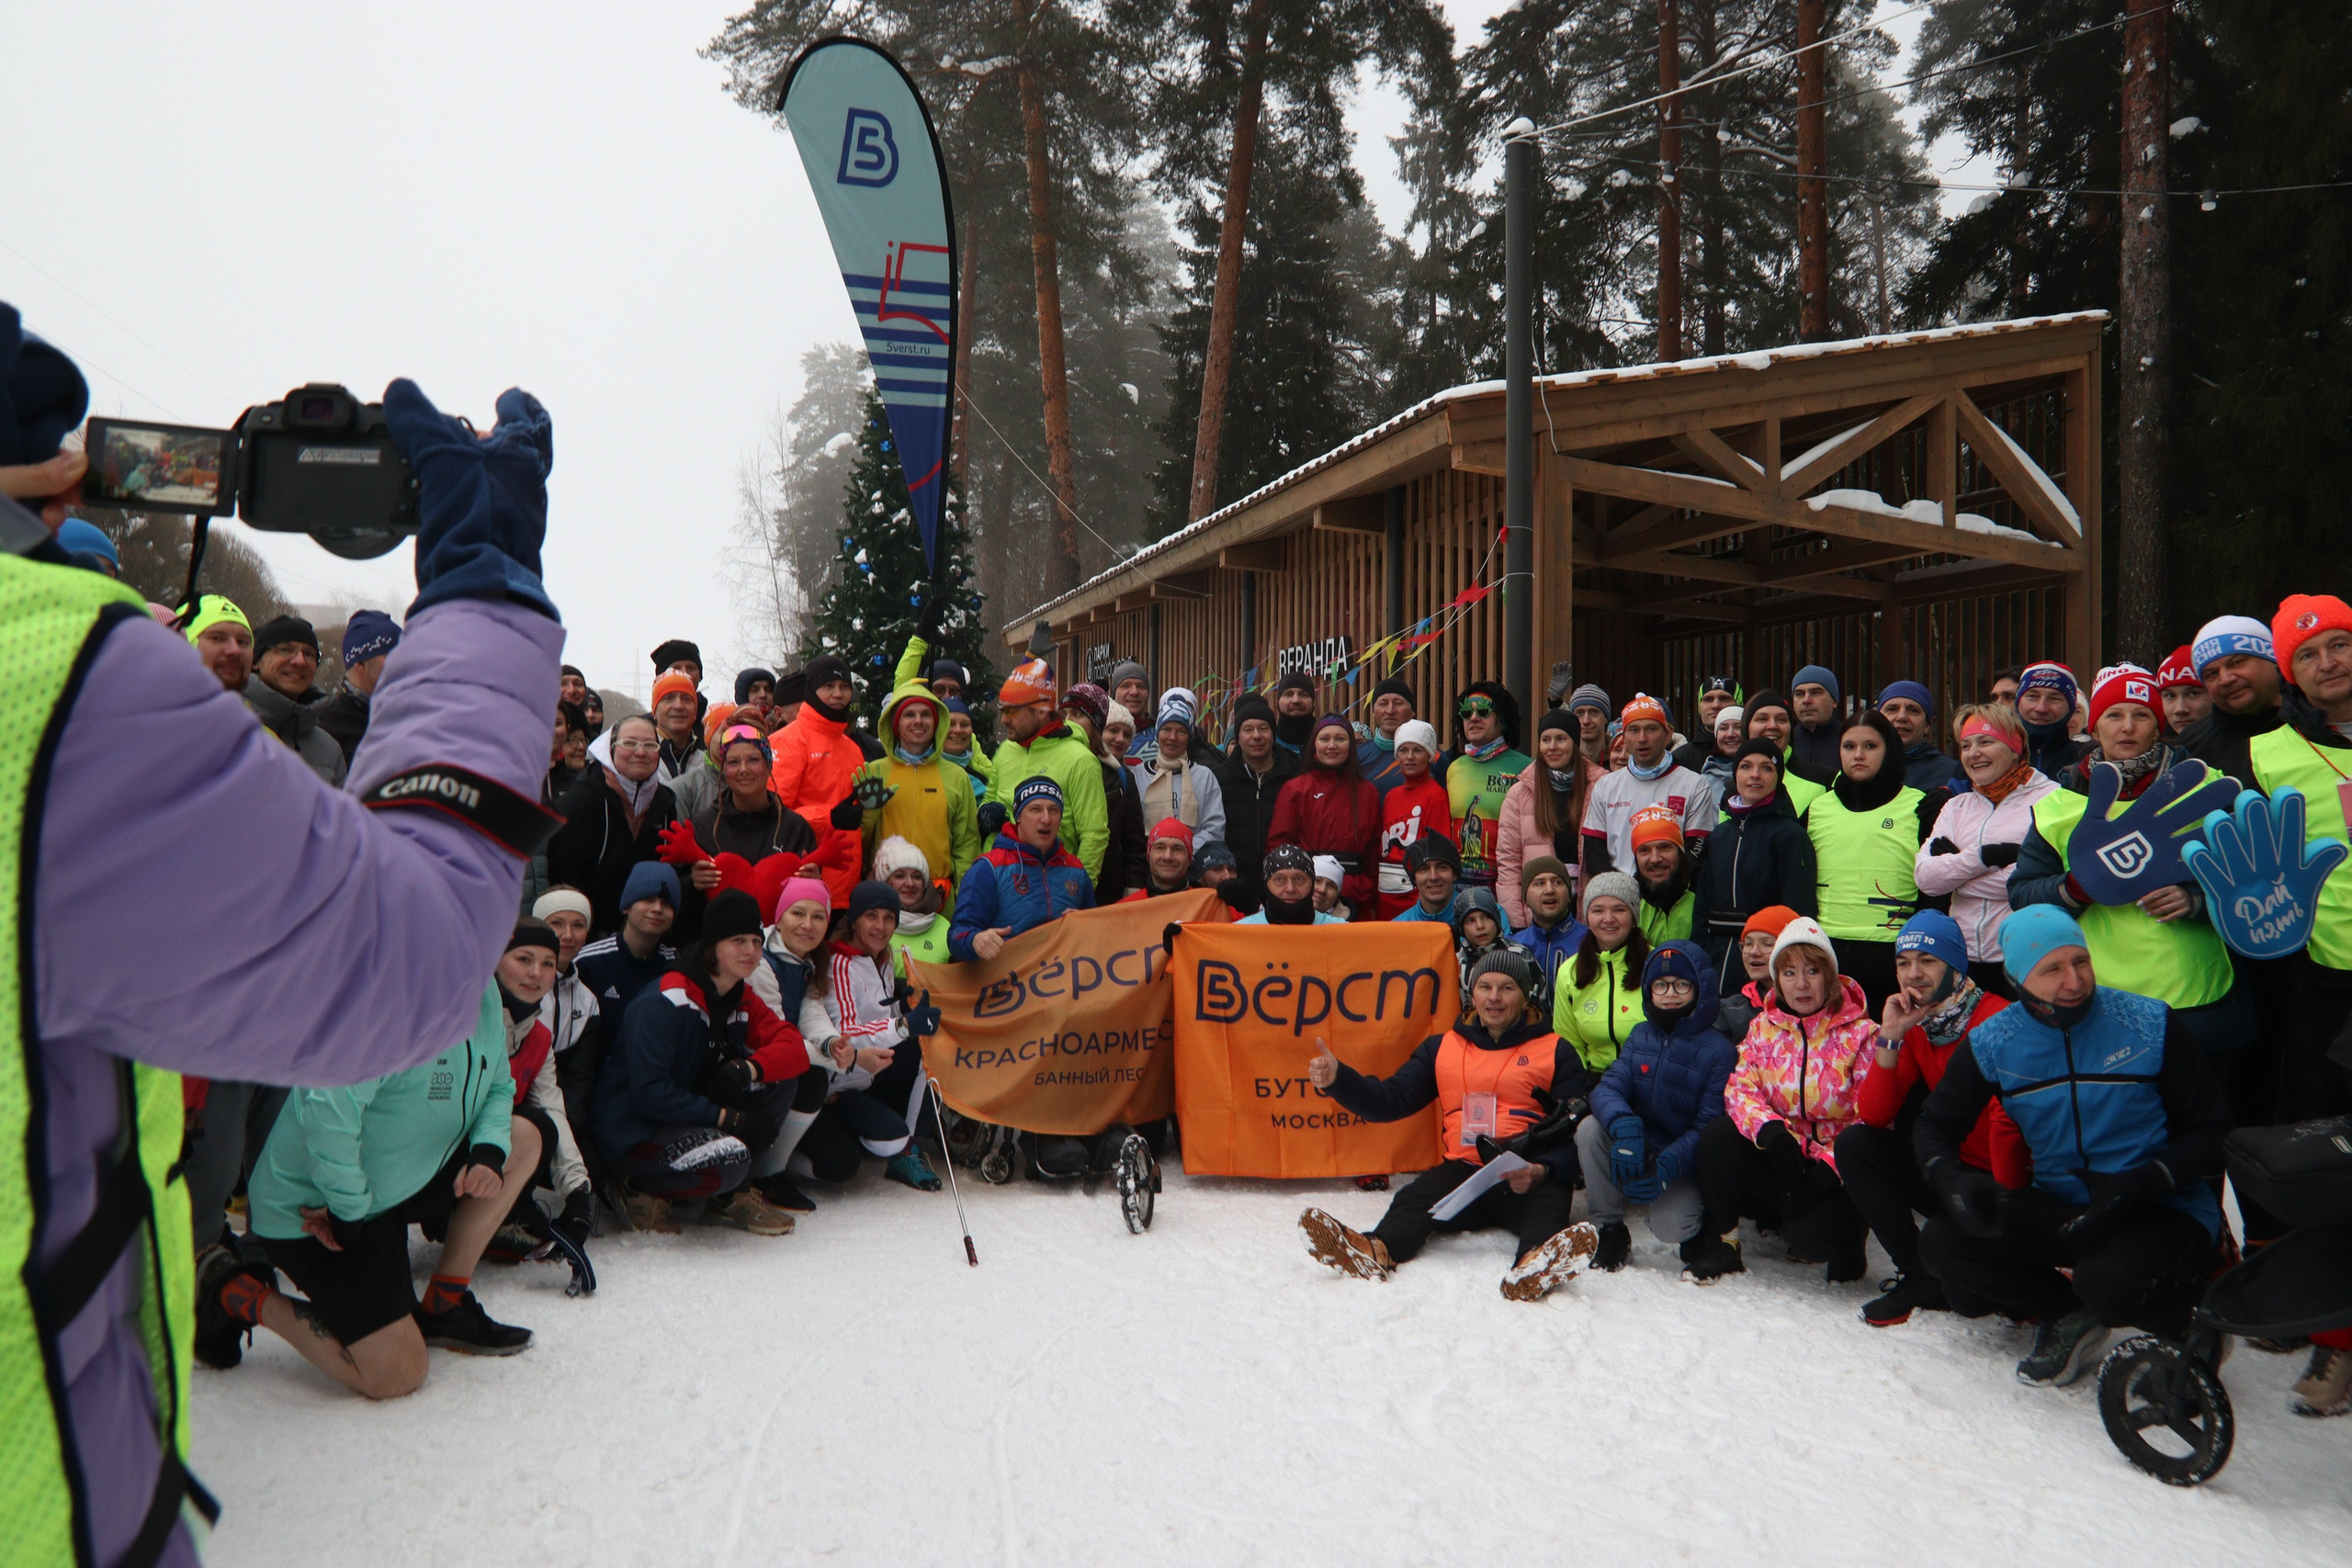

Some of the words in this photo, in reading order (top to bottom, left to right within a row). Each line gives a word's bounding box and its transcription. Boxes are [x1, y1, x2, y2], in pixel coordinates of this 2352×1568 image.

[887, 341, 931, 355] 5verst.ru
[2230, 635, 2276, 659] 202
[379, 773, 481, 808] Canon
[2234, 871, 2294, 927] Дай
[2249, 901, 2304, 944] пять
[1896, 934, 1923, 945] ТЕМП
[1035, 1068, 1110, 1086] БАННЫЙ
[1114, 1067, 1146, 1082] ЛЕС
[1272, 1112, 1367, 1130] МОСКВА
